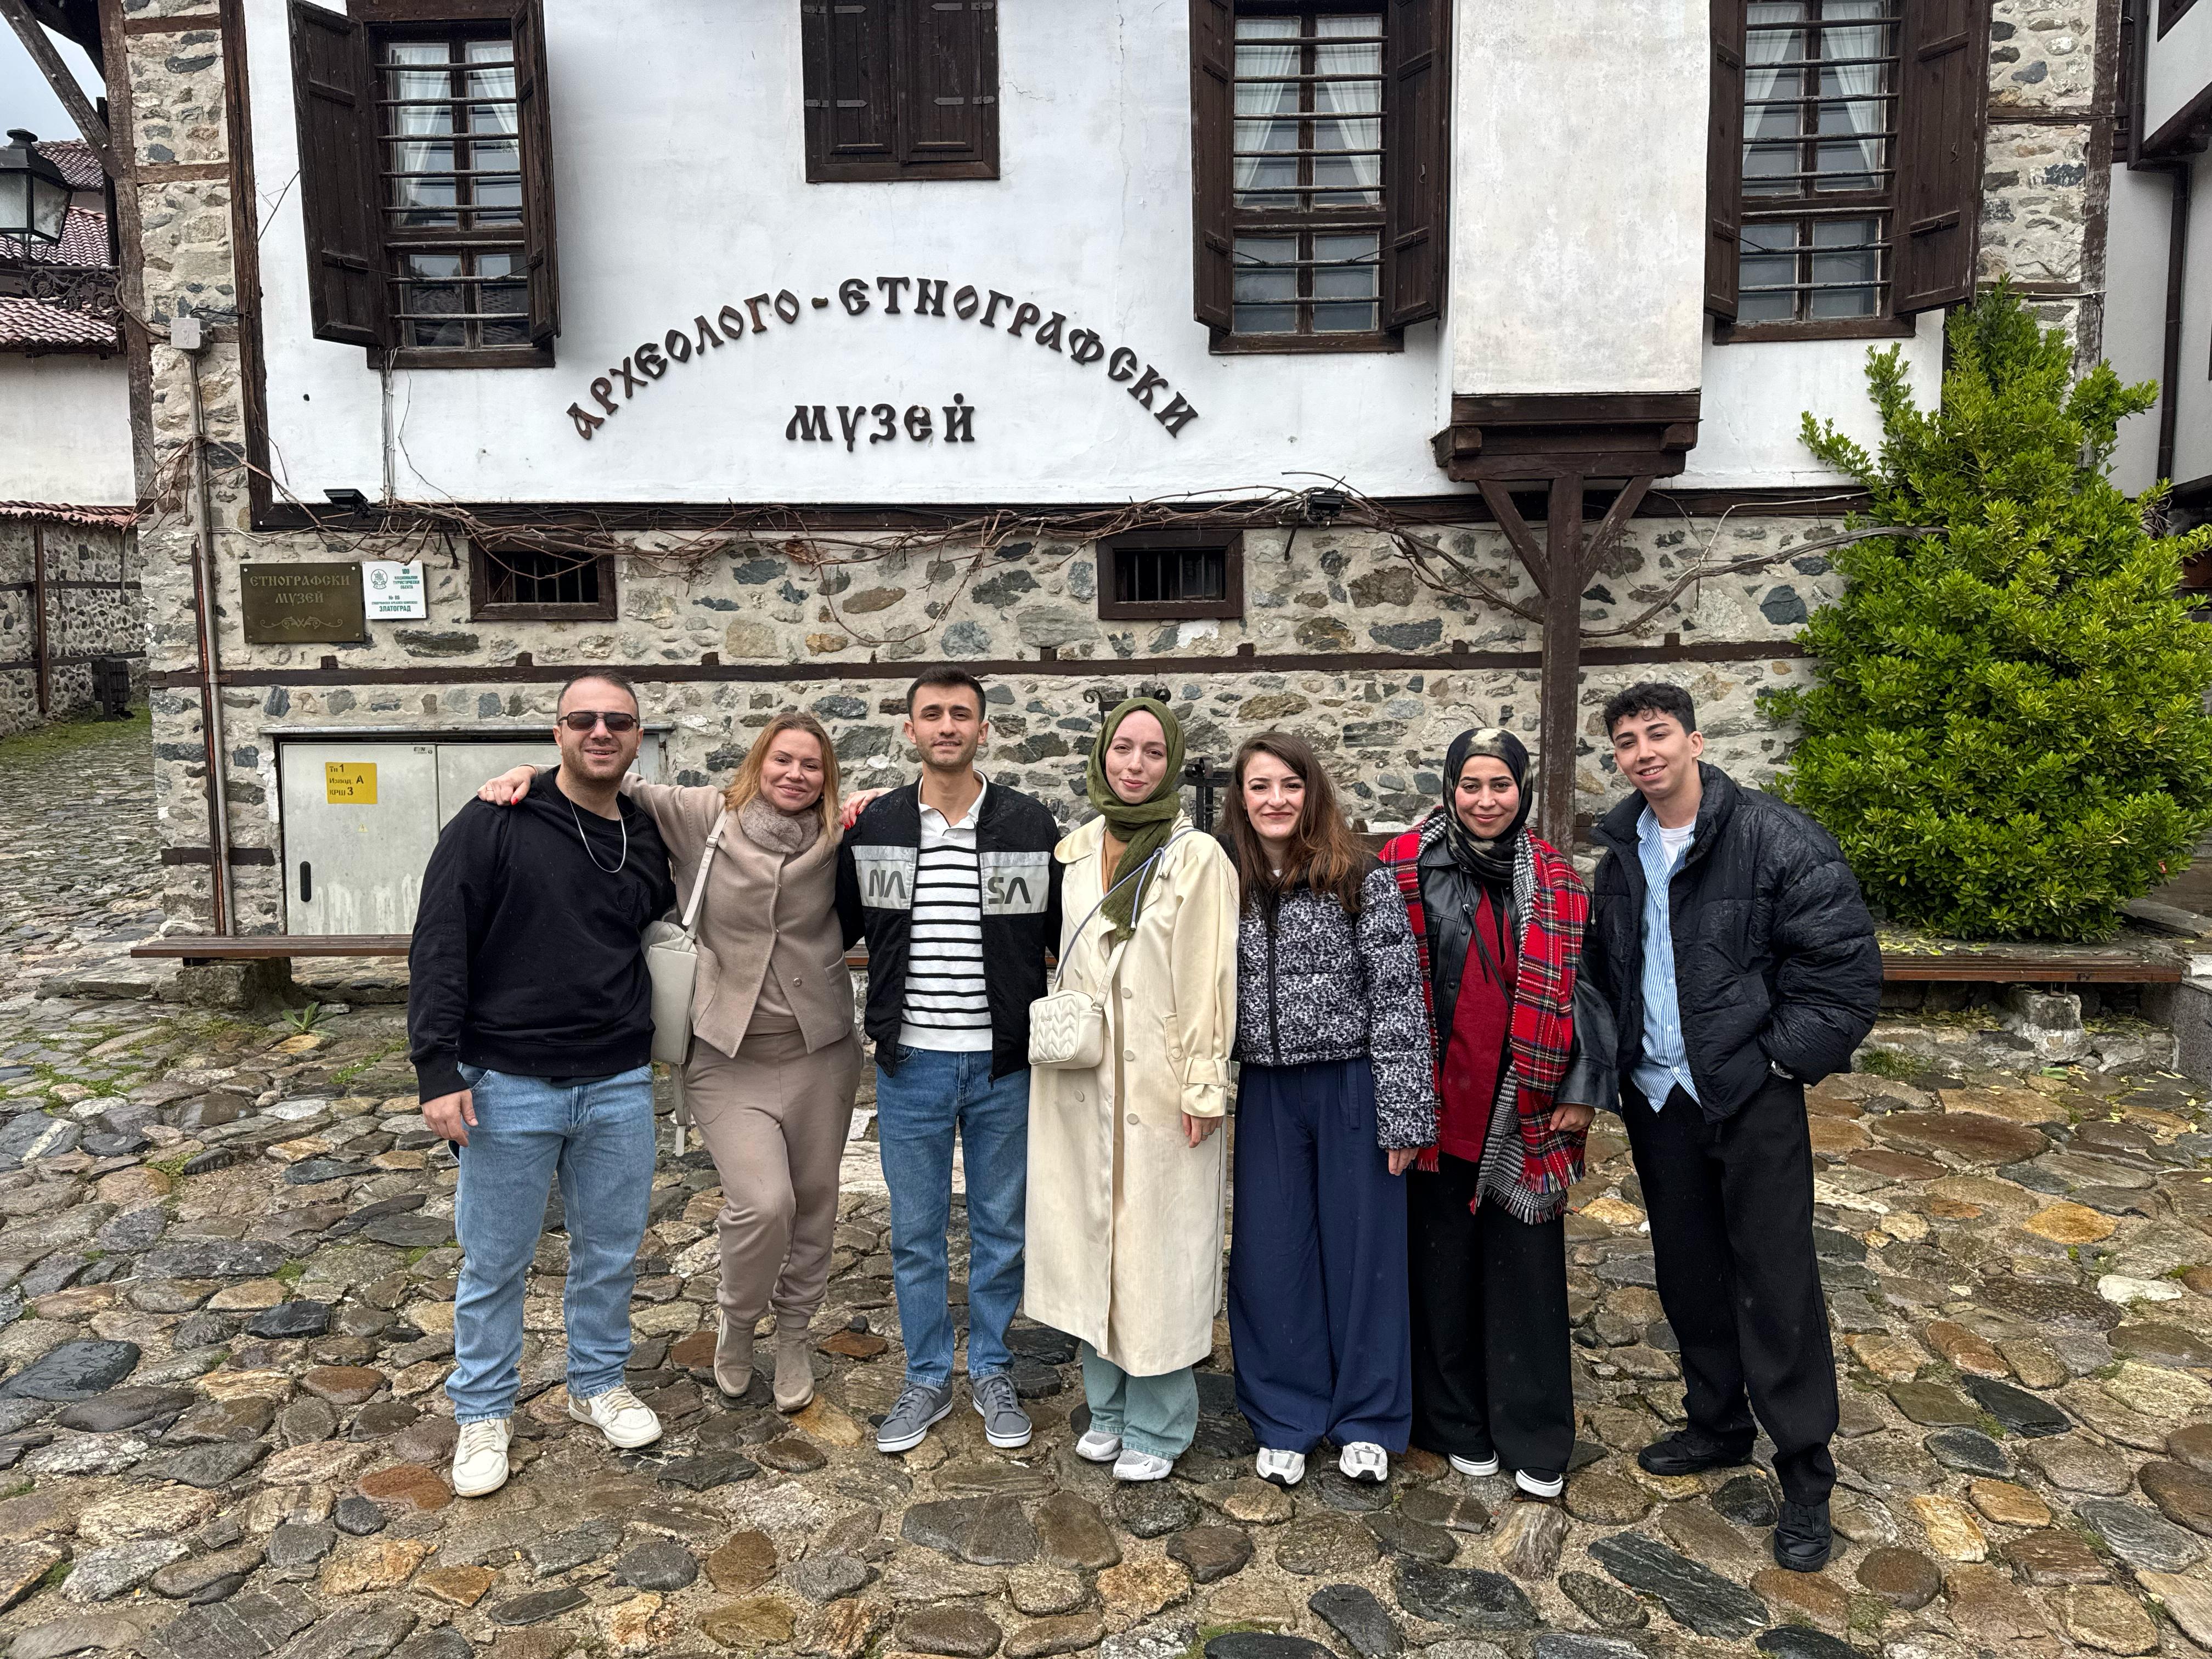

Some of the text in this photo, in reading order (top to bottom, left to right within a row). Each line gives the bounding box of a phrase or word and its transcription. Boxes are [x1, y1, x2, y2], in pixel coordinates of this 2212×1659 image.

[785, 393, 975, 453] МУЗЕЙ
[250, 574, 350, 587] ЕТНОГРАФСКИ
[275, 591, 324, 606] МУЗЕЙ
[339, 764, 344, 773] 1
[347, 787, 353, 795] 3
